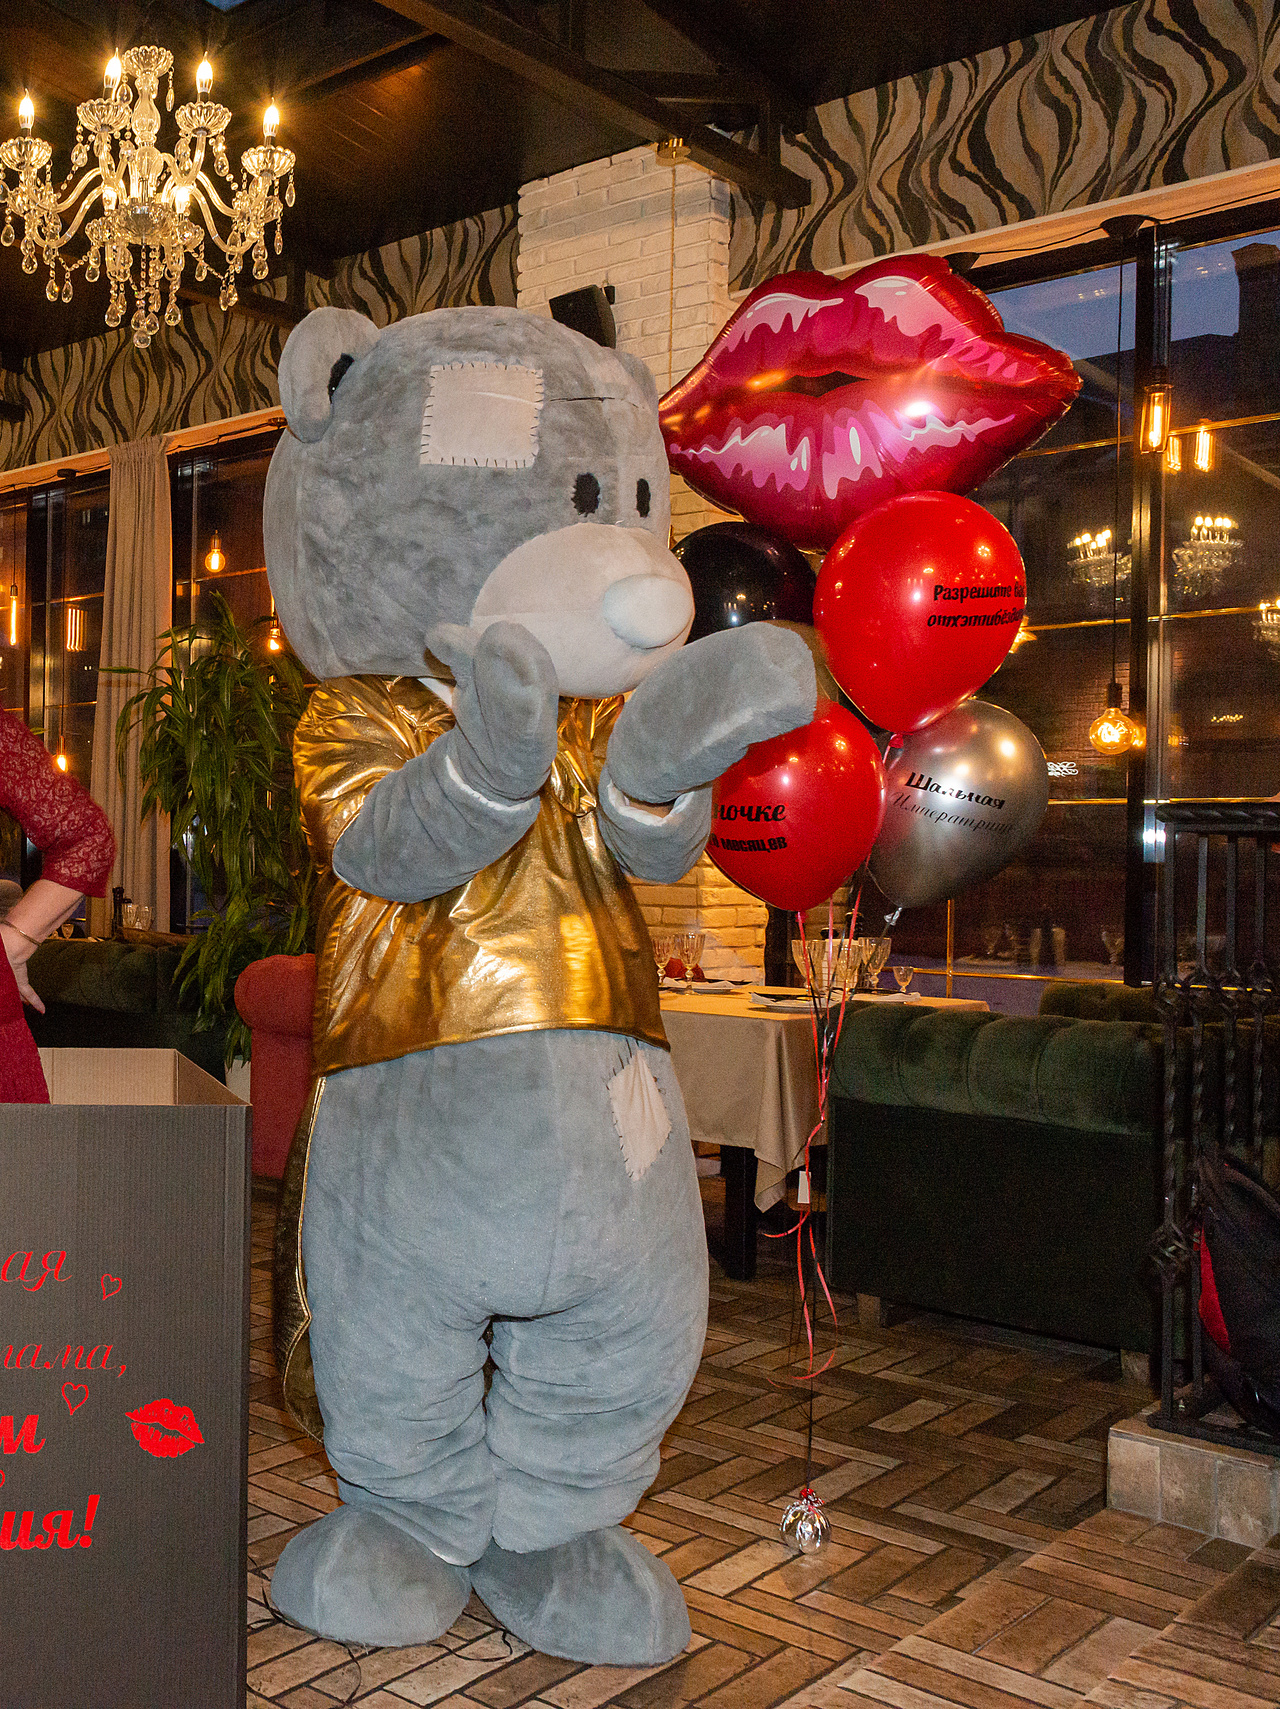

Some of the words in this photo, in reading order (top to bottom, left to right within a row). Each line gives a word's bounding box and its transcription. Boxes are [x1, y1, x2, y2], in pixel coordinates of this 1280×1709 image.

[933, 584, 1012, 604] Разрешите
[904, 771, 1005, 810] Шальная
[720, 836, 788, 853] месяцев
